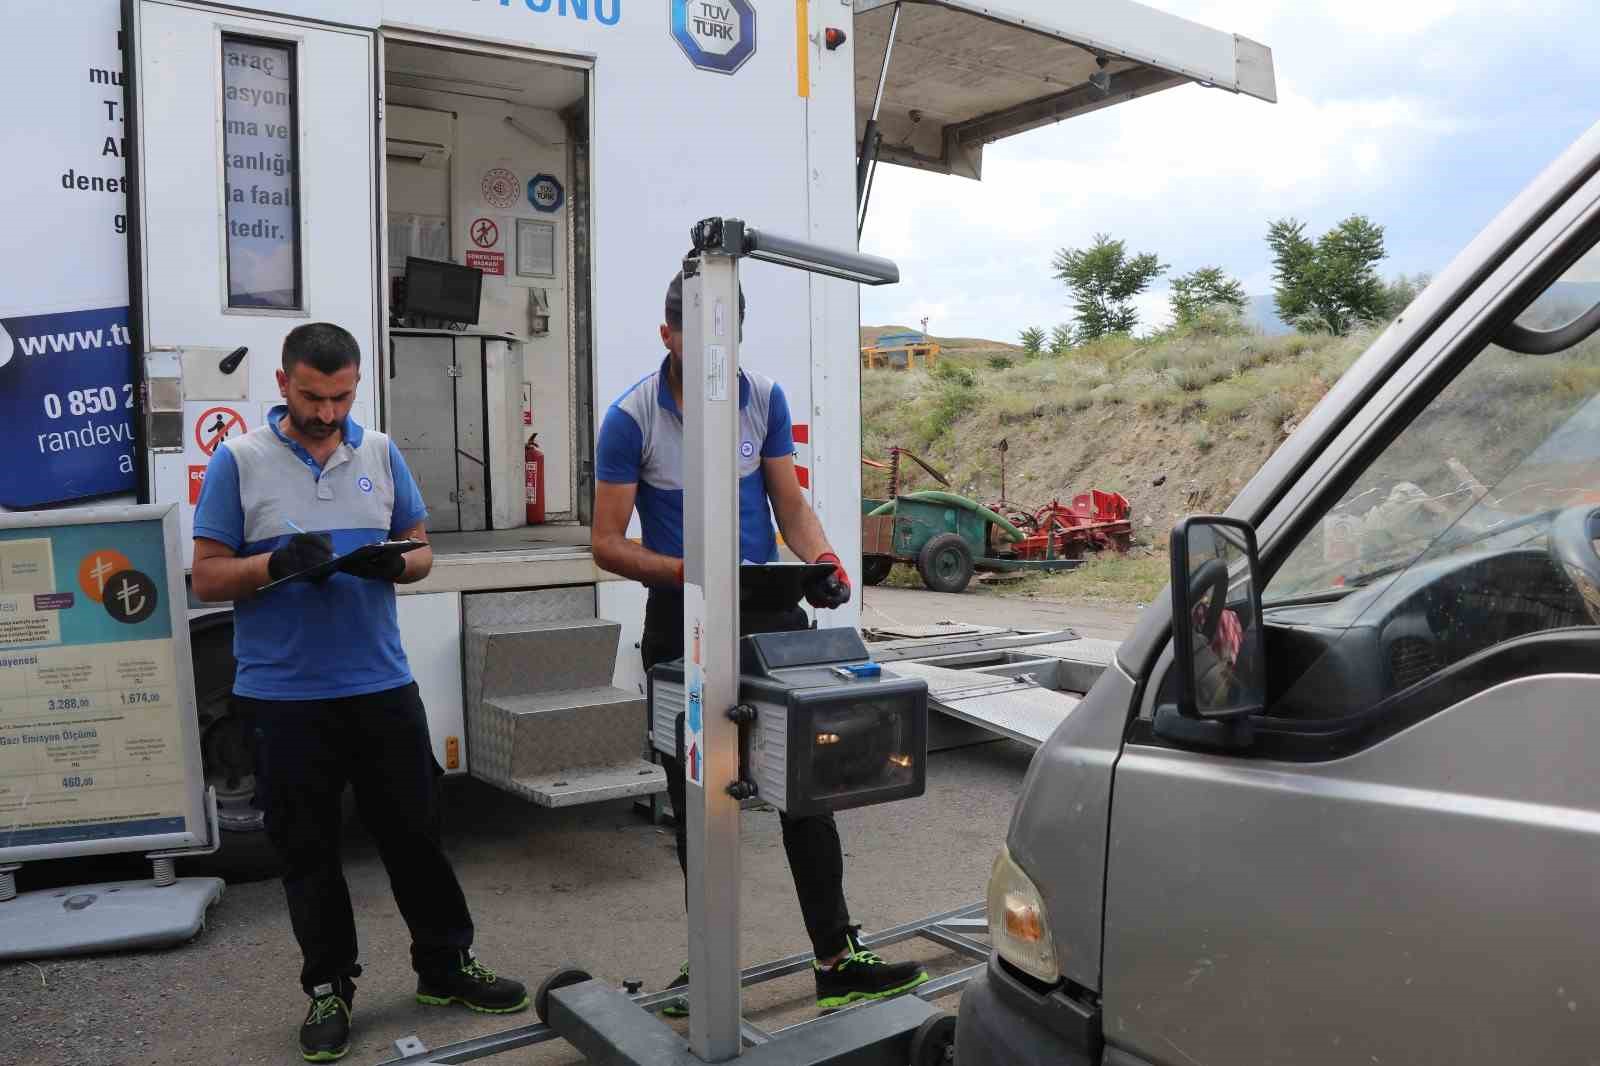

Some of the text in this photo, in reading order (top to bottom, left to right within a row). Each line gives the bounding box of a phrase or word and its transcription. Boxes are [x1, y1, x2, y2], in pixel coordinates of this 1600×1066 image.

[700, 2, 730, 21] TÜV
[693, 19, 734, 41] TÜRK
[44, 393, 62, 419] 0
[69, 385, 117, 416] 850
[118, 445, 136, 474] a
